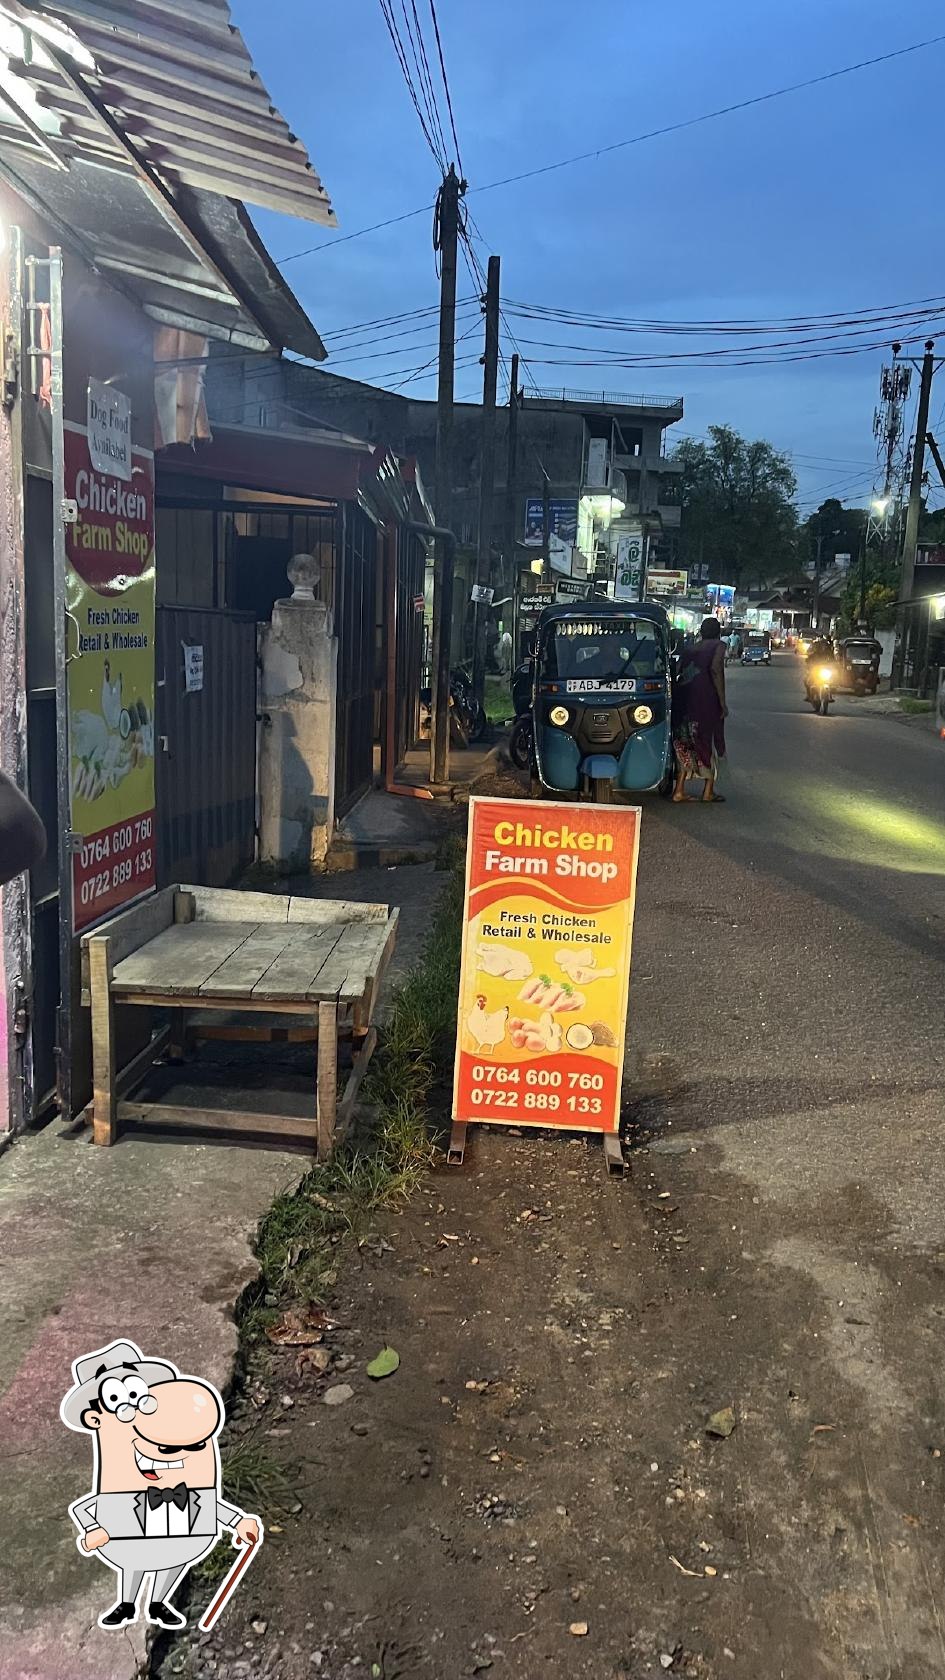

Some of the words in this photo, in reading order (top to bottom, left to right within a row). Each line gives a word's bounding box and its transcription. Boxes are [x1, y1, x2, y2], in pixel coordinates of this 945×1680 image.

[90, 399, 107, 430] Dog
[109, 408, 129, 434] Food
[76, 470, 146, 520] Chicken
[73, 515, 112, 550] Farm
[115, 521, 148, 562] Shop
[87, 607, 110, 625] Fresh
[111, 607, 140, 625] Chicken
[79, 633, 101, 652] Retail
[103, 633, 110, 650] &
[112, 632, 148, 649] Wholesale
[80, 835, 110, 869] 0764
[113, 826, 132, 853] 600
[135, 817, 151, 843] 760
[494, 821, 614, 852] Chicken
[81, 870, 110, 905] 0722
[113, 859, 132, 887] 889
[135, 849, 151, 874] 133
[484, 850, 548, 875] Farm
[555, 854, 618, 883] Shop
[482, 924, 522, 938] Retail
[527, 928, 537, 939] &
[541, 929, 612, 944] Wholesale
[500, 911, 537, 924] Fresh
[542, 914, 596, 928] Chicken
[472, 1065, 520, 1084] 0764
[525, 1069, 562, 1087] 600
[567, 1072, 604, 1090] 760
[470, 1088, 518, 1107] 0722
[524, 1092, 561, 1110] 889
[566, 1095, 602, 1114] 133
